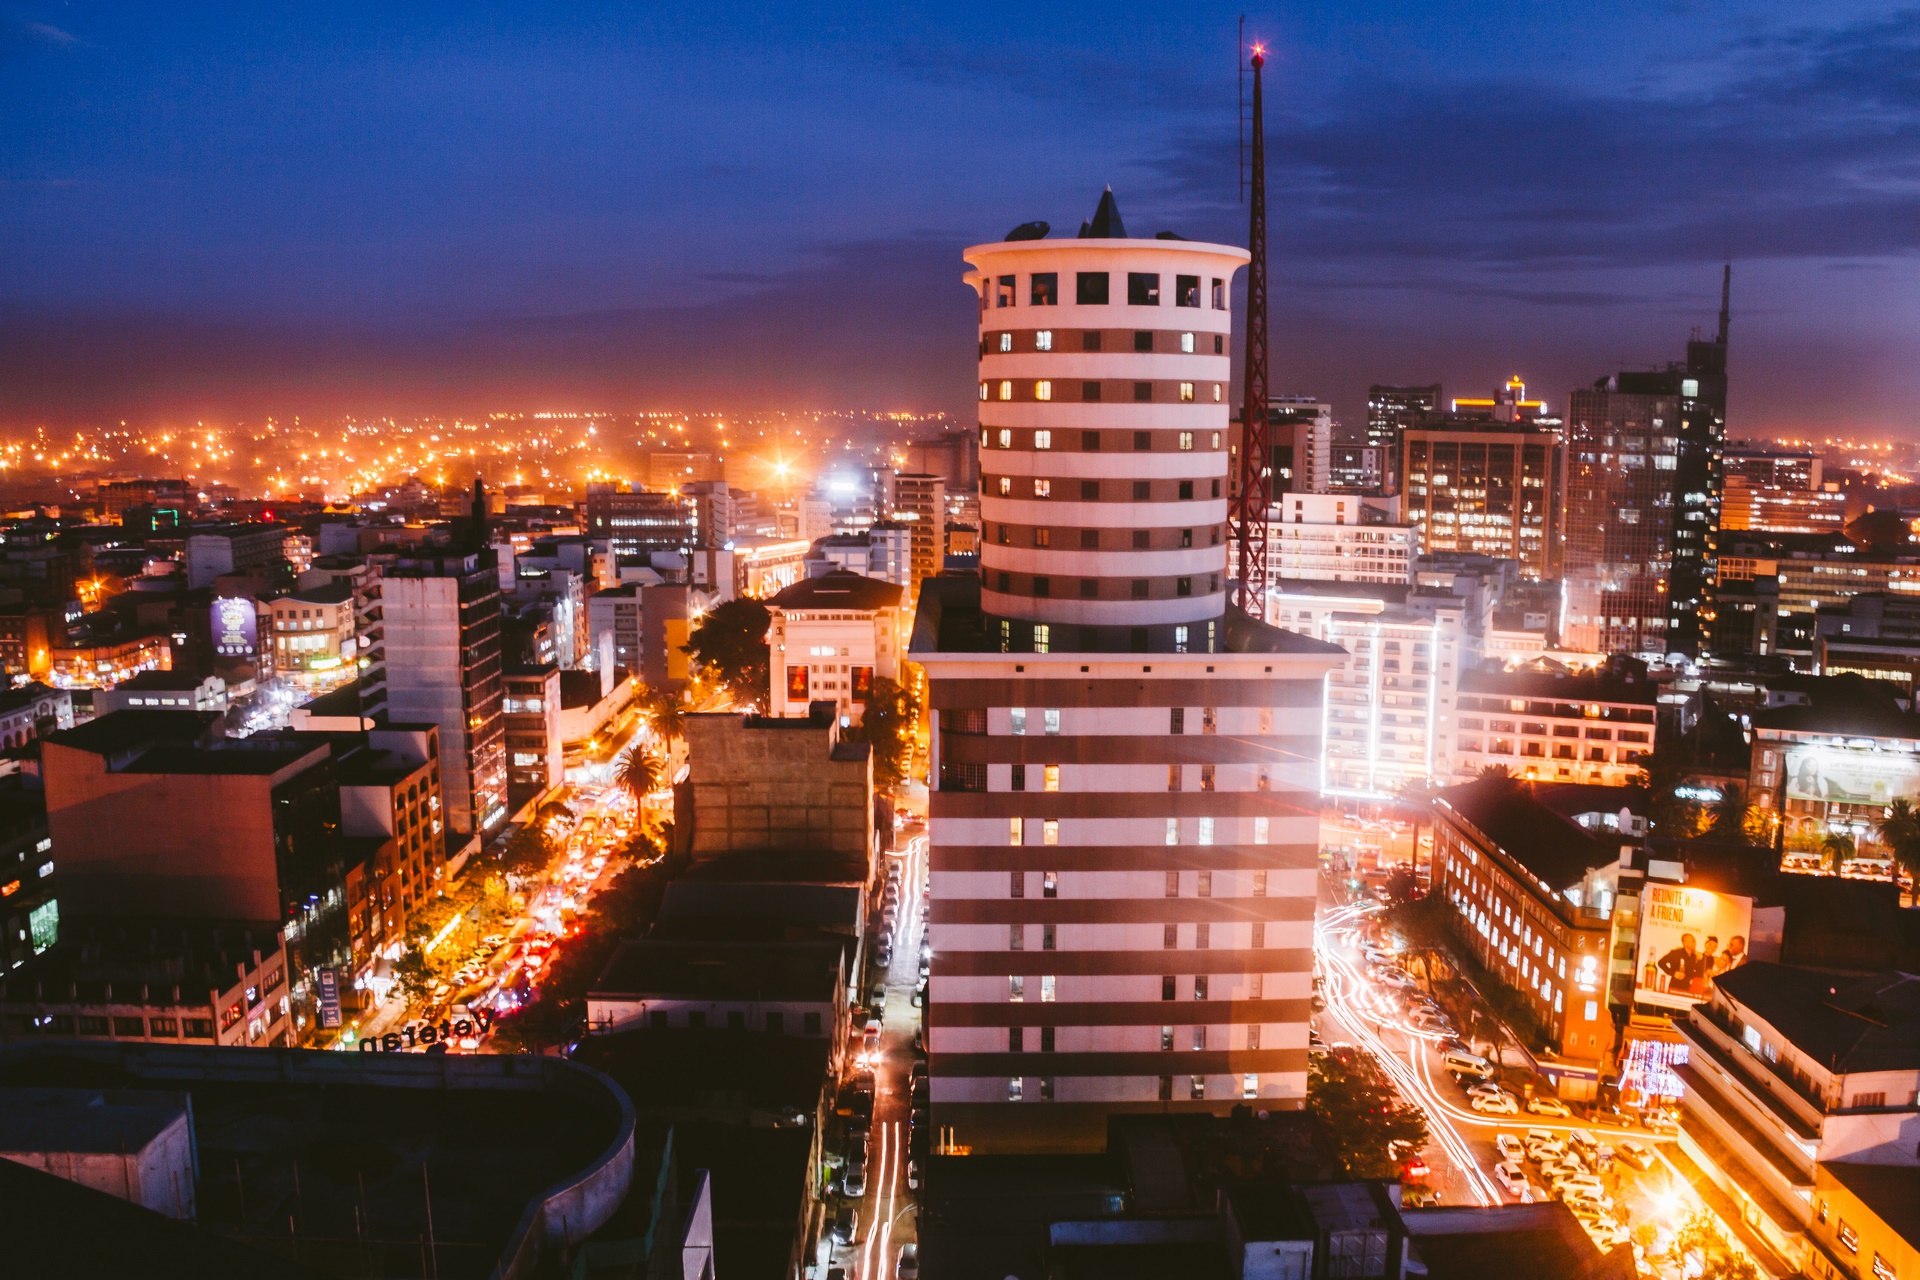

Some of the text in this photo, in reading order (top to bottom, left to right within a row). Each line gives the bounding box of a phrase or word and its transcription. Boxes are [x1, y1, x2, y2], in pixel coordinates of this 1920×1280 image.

[1652, 887, 1683, 906] REUNITE
[1650, 903, 1684, 923] A FRIEND
